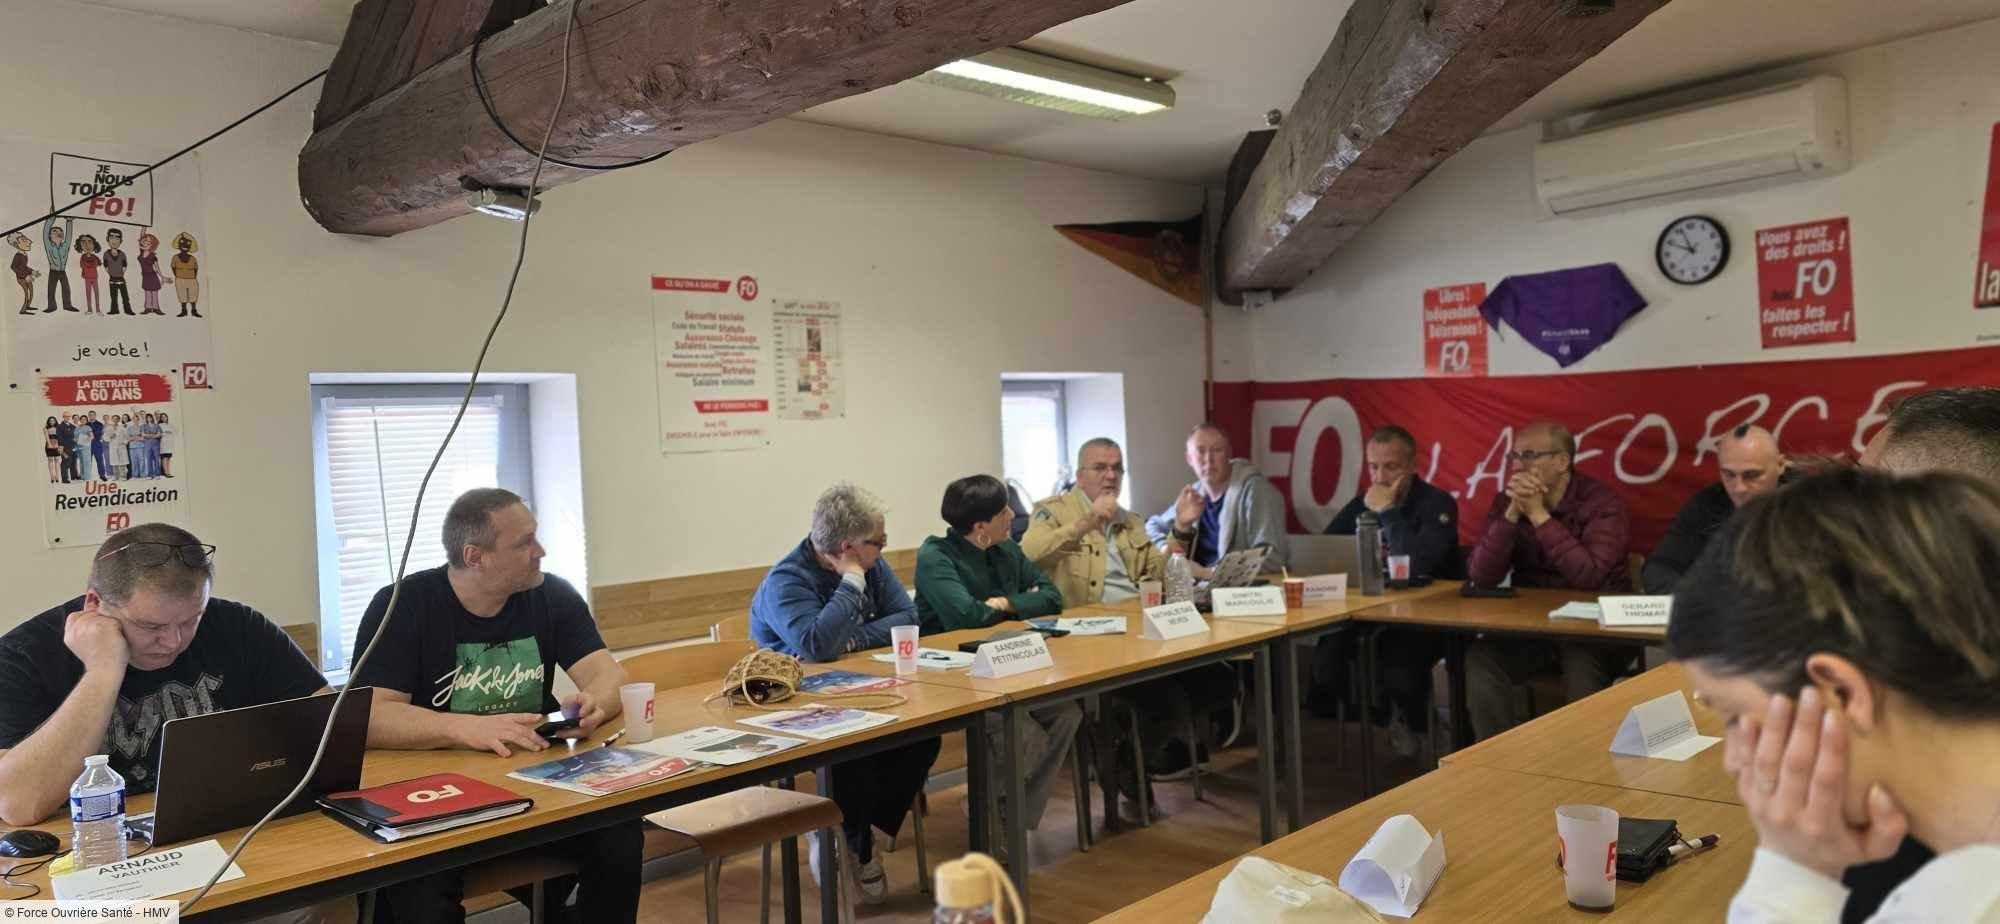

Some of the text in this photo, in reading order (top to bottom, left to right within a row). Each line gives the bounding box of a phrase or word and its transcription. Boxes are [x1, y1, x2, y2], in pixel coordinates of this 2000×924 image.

[96, 164, 111, 174] JE
[94, 173, 134, 186] NOUS
[69, 182, 116, 198] TOUS
[88, 197, 124, 216] FO
[1759, 226, 1828, 247] Vous avez
[1765, 245, 1789, 261] des
[1793, 239, 1835, 257] droits
[1794, 258, 1837, 299] FO
[740, 280, 756, 297] FO
[1762, 304, 1826, 324] faites les
[1772, 319, 1840, 340] respecter
[72, 342, 151, 361] je vote !
[1441, 340, 1470, 372] FO
[77, 378, 140, 389] LA RETRAITE
[184, 366, 206, 385] FO
[90, 388, 109, 402] 60
[112, 387, 143, 401] ANS
[1251, 396, 1364, 534] FO
[85, 480, 118, 495] Une
[55, 486, 178, 511] Revendication
[107, 512, 130, 530] FO
[898, 640, 913, 656] FO
[992, 646, 1046, 665] PETITNICOLAS
[993, 638, 1033, 654] SANDRINE
[478, 701, 518, 712] LEGACY
[407, 784, 464, 803] FO
[98, 851, 183, 875] ARNAUD
[111, 860, 180, 879] VAUTHIER
